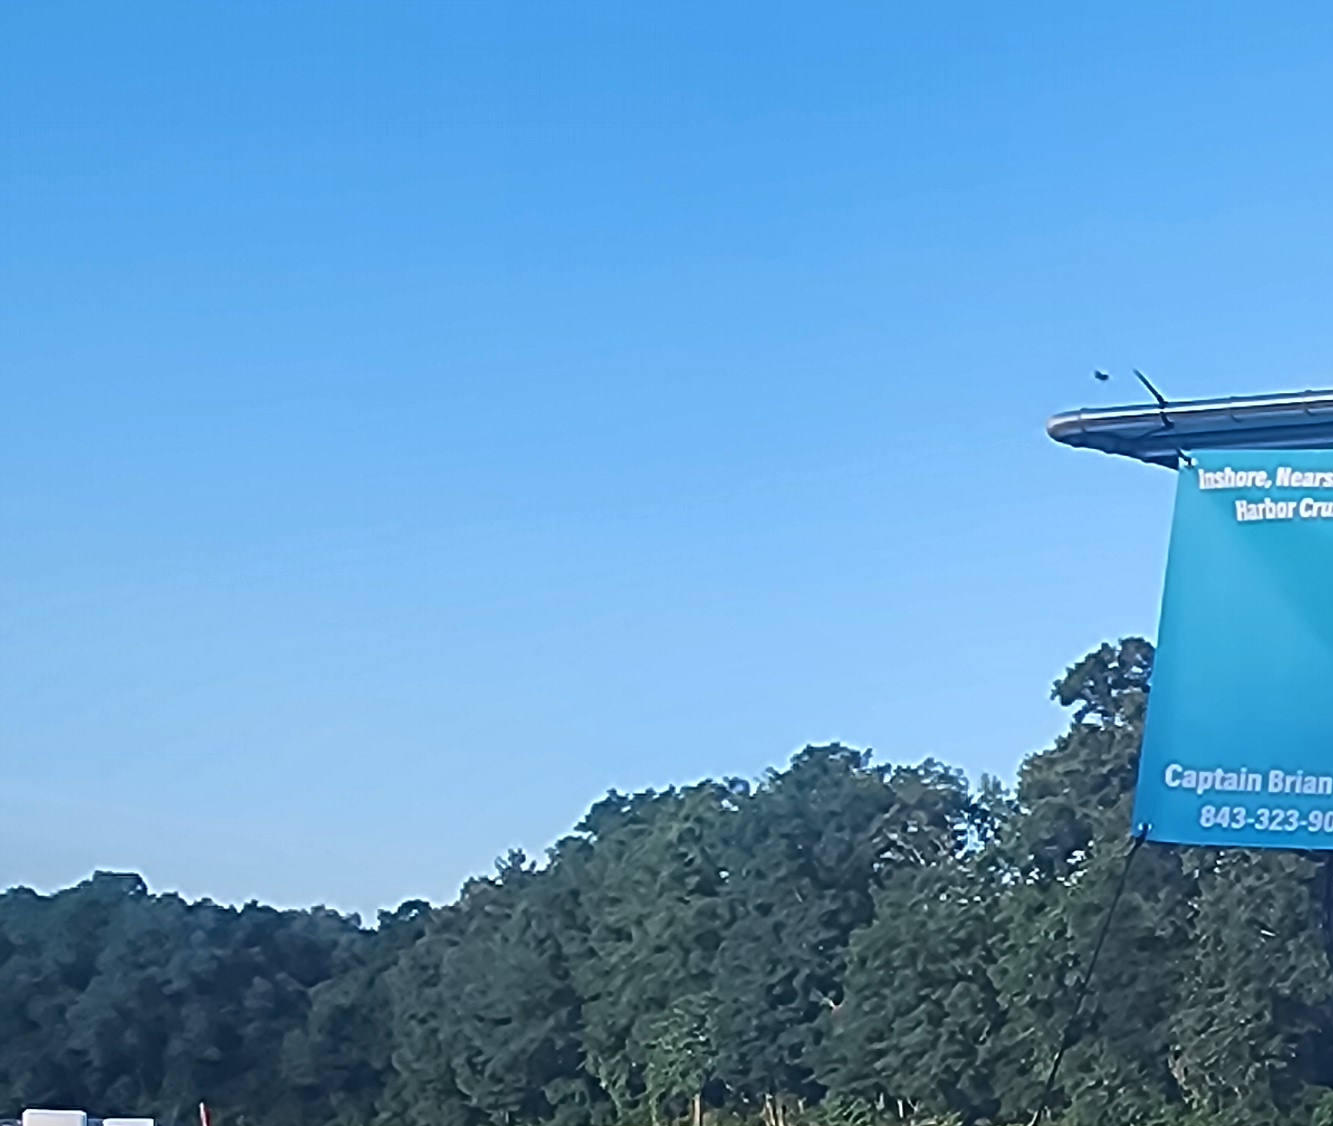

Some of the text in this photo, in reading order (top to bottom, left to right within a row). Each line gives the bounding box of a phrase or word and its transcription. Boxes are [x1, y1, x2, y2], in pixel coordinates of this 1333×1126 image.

[1198, 467, 1272, 489] Inshore,
[1235, 498, 1297, 521] Harbor
[1165, 763, 1262, 795] Captain
[1267, 769, 1333, 794] Brian
